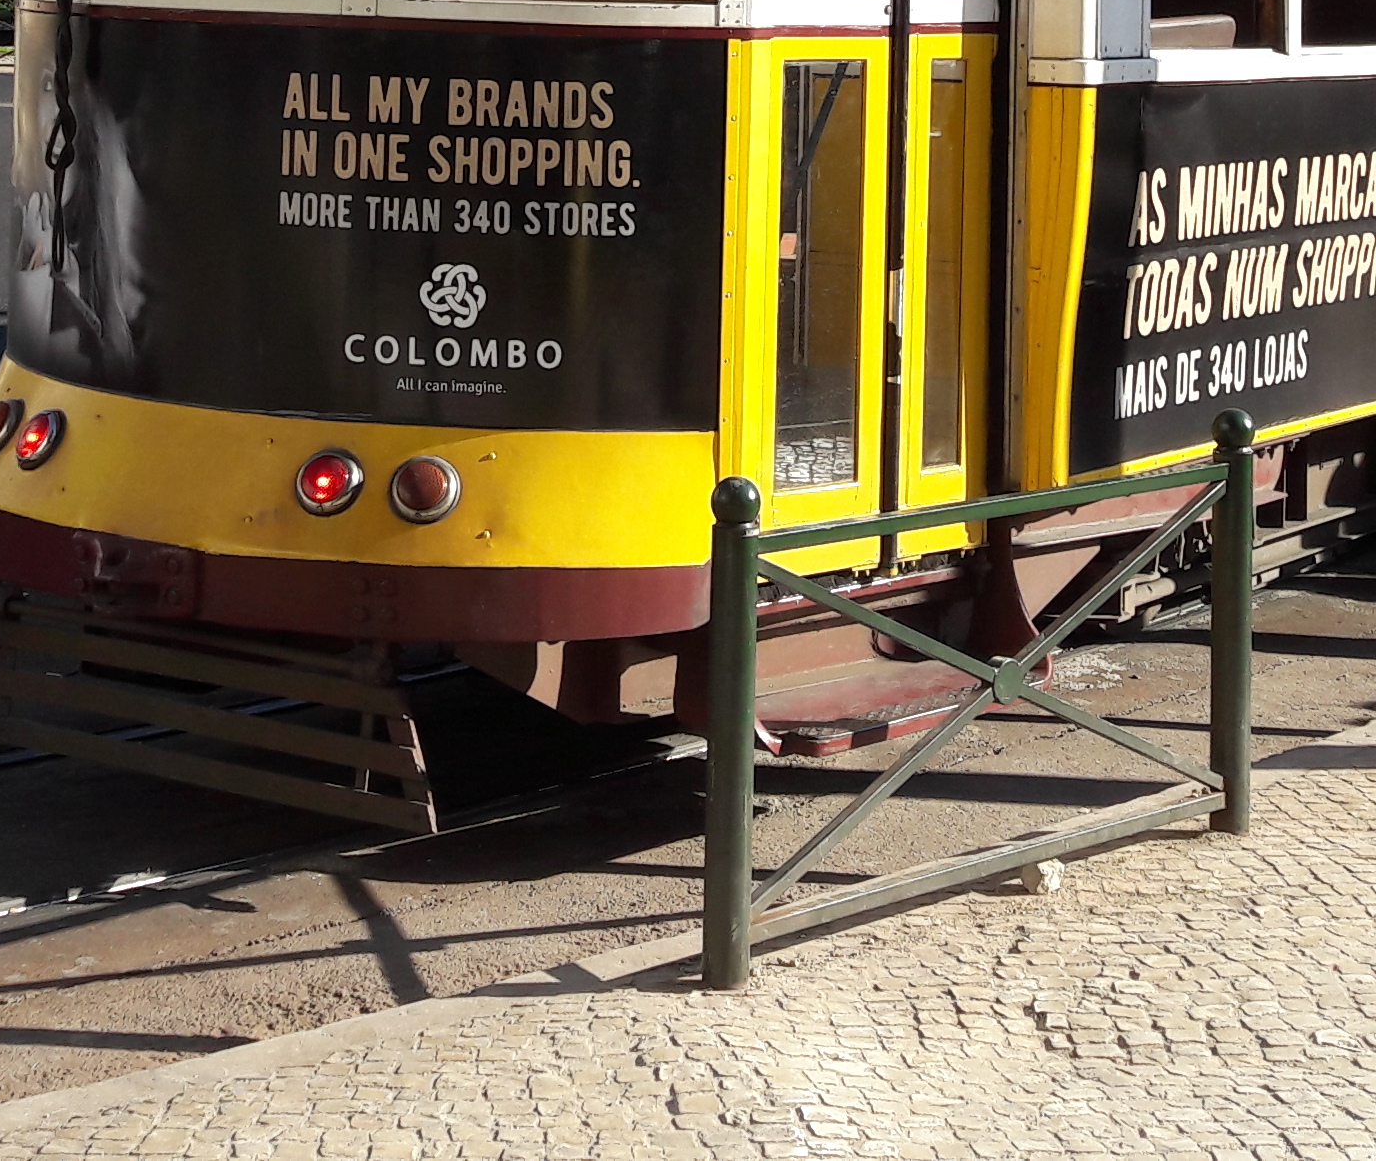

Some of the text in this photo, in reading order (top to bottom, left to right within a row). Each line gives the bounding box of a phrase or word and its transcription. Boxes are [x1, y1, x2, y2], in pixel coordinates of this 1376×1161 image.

[283, 72, 615, 129] ALL MY BRANDS
[281, 129, 641, 188] IN ONE SHOPPING.
[279, 191, 636, 237] MORE THAN 340 STORES
[1127, 167, 1167, 247] AS
[1177, 157, 1288, 241] MINHAS
[1123, 251, 1218, 340] TODAS
[1221, 243, 1289, 321] NUM
[344, 333, 563, 370] COLOMBO
[1114, 329, 1309, 420] MAIS DE 340 LOJAS
[396, 377, 414, 391] All
[424, 381, 449, 392] can
[451, 379, 507, 396] imagine.
